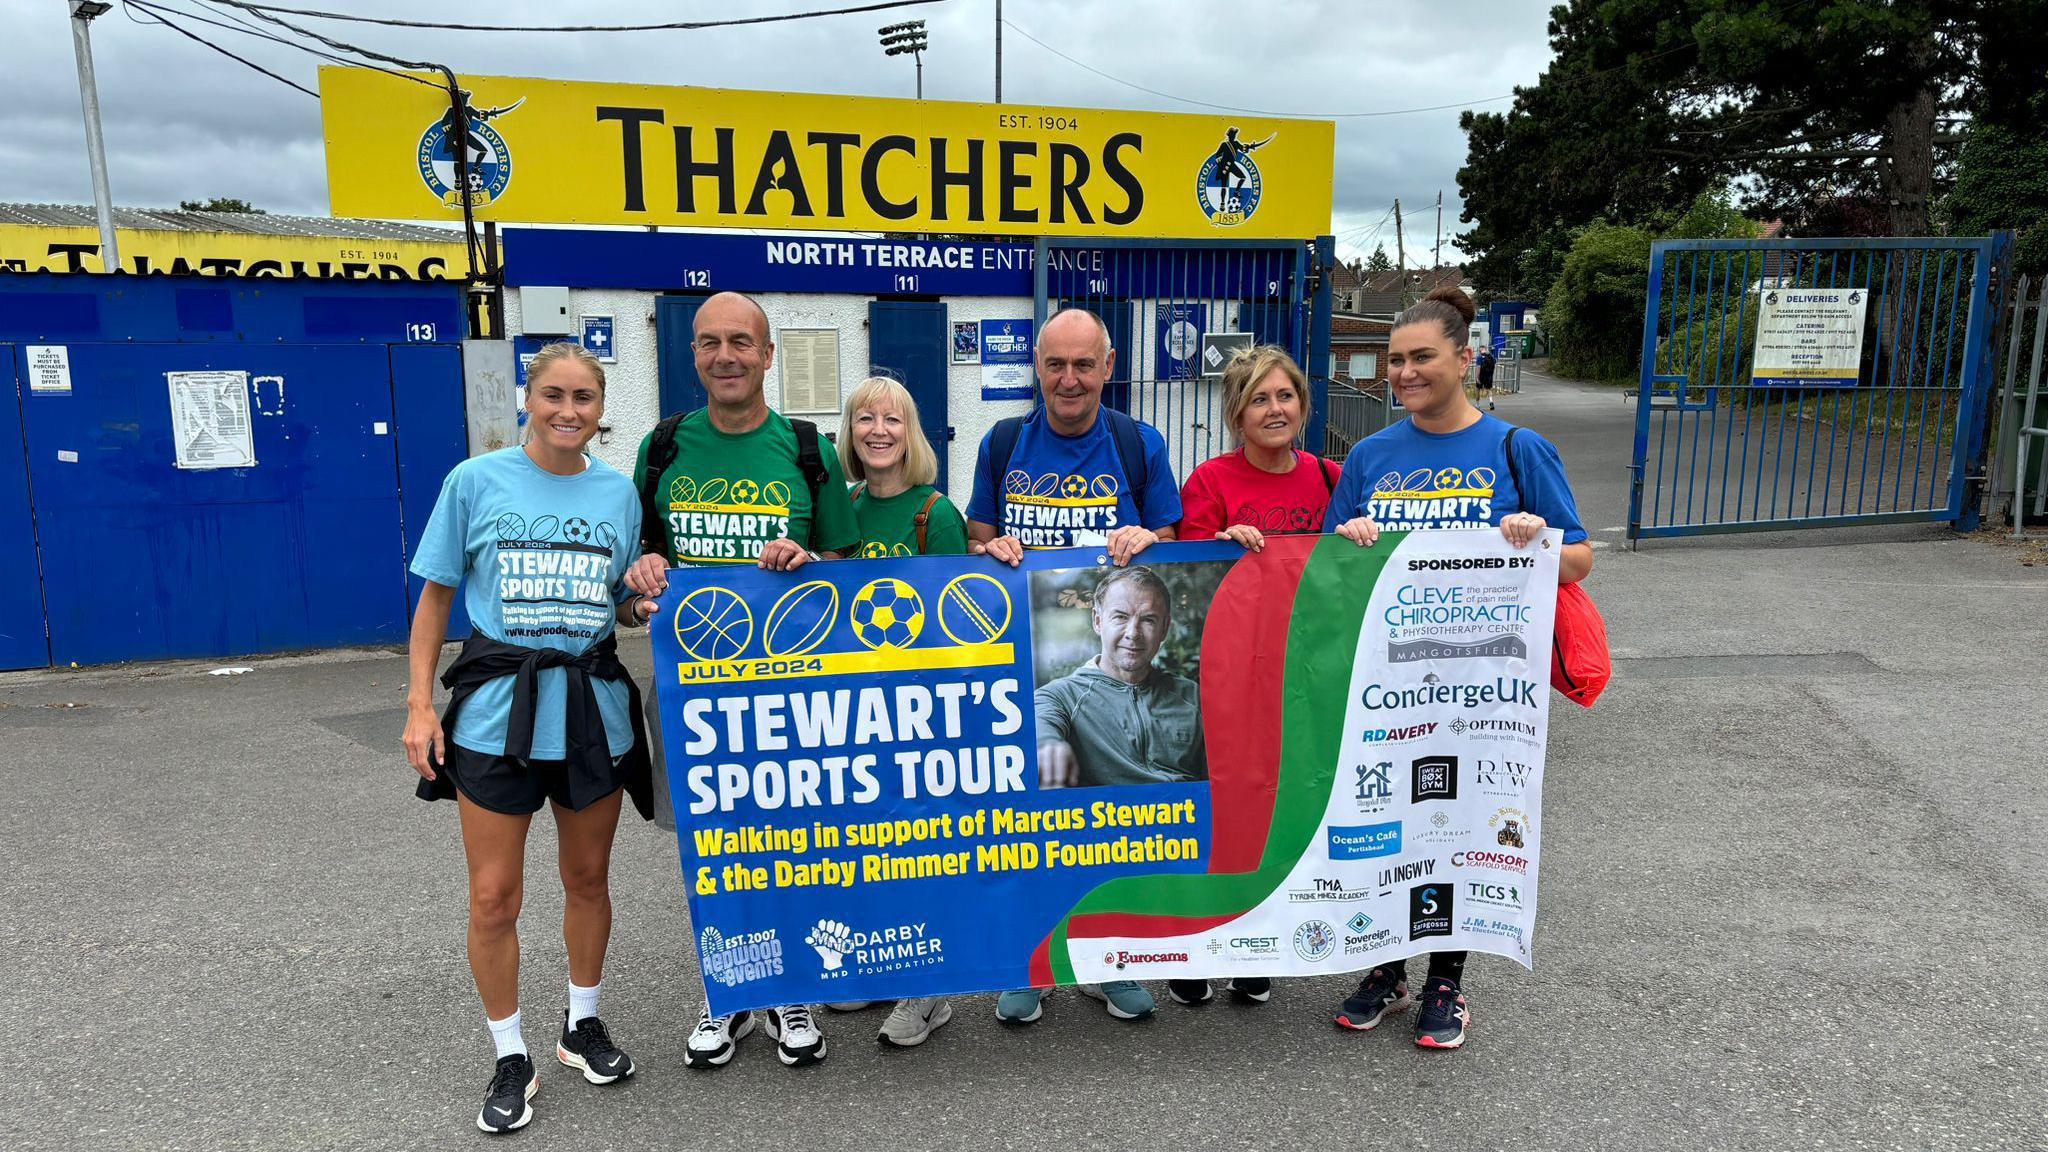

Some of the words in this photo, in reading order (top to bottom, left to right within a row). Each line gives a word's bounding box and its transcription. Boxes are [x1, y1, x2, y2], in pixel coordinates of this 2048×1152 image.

[999, 113, 1033, 130] EST.
[1038, 116, 1078, 131] 1904
[420, 131, 440, 188] BRISTOL
[477, 124, 508, 172] ROVERS
[596, 105, 1144, 225] THATCHERS
[1199, 162, 1213, 209] BRISTOL
[1241, 156, 1259, 196] ROVERS
[1218, 214, 1240, 223] 1883
[340, 250, 365, 260] EST.
[373, 251, 399, 261] 1904
[766, 241, 855, 266] NORTH
[861, 244, 974, 269] TERRACE
[1786, 295, 1840, 303] DELIVERIES
[670, 502, 692, 510] JULY
[693, 503, 719, 511] 2024
[1006, 494, 1025, 502] JULY
[1026, 496, 1050, 504] 2024
[1004, 502, 1118, 528] STEWART'S
[1366, 497, 1492, 520] STEWART'S
[668, 512, 790, 538] STEWART'S
[498, 541, 523, 549] JULY
[673, 536, 736, 558] SPORTS
[497, 551, 612, 581] STEWART'S
[1408, 557, 1505, 571] SPONSORED
[1508, 556, 1535, 569] BY:
[500, 577, 566, 600] SPORTS
[1397, 585, 1463, 606] CLEVE
[1467, 586, 1481, 594] the
[1482, 585, 1518, 597] practice
[1465, 595, 1477, 603] of
[1477, 595, 1496, 605] pain
[1498, 593, 1519, 603] relief
[1384, 604, 1531, 627] CHIROPRACTIC
[1389, 628, 1399, 639] &
[1402, 625, 1484, 637] PHYSIOTHERAPY
[1487, 623, 1524, 634] CENTRE
[1396, 646, 1519, 661] MANGOTSFIELD
[682, 663, 748, 681] JULY
[754, 658, 823, 676] 2024
[1361, 676, 1538, 711] ConciergeUK
[682, 678, 1023, 756] STEWART'S
[1469, 719, 1536, 737] OPTIMUM
[1469, 733, 1499, 742] Building
[687, 754, 881, 815] SPORTS
[894, 744, 1026, 799] TOUR
[1421, 781, 1443, 790] GYM
[693, 823, 807, 857] Walking
[814, 822, 840, 848] in
[846, 813, 952, 847] support
[958, 809, 986, 837] of
[992, 806, 1085, 835] Marcus
[1091, 798, 1196, 829] Stewart
[1377, 830, 1398, 842] Café
[1443, 829, 1471, 837] DREAM
[1347, 843, 1385, 854] Portishead
[695, 867, 717, 896] &
[721, 862, 768, 892] the
[774, 856, 856, 888] Darby
[862, 847, 970, 883] Rimmer
[976, 842, 1039, 873] MND
[1045, 833, 1199, 869] Foundation
[1465, 850, 1528, 870] CONSORT
[1466, 860, 1500, 870] SCAFFOLD
[1500, 863, 1527, 876] SERVICES
[1313, 878, 1343, 892] TMA
[1468, 882, 1505, 900] TICS
[1338, 890, 1370, 900] ACADEMY
[1413, 921, 1449, 931] Saragossa
[1462, 917, 1488, 928] J.M.
[1472, 926, 1505, 936] Electrical
[725, 935, 747, 950] EST.
[747, 928, 776, 944] 2007
[853, 923, 926, 947] DARBY
[1230, 937, 1279, 948] CREST
[1344, 927, 1390, 945] Sovereign
[856, 938, 943, 964] RIMMER
[1117, 950, 1189, 965] Eurocams
[858, 956, 945, 975] FOUNDATION
[821, 970, 849, 980] MND
